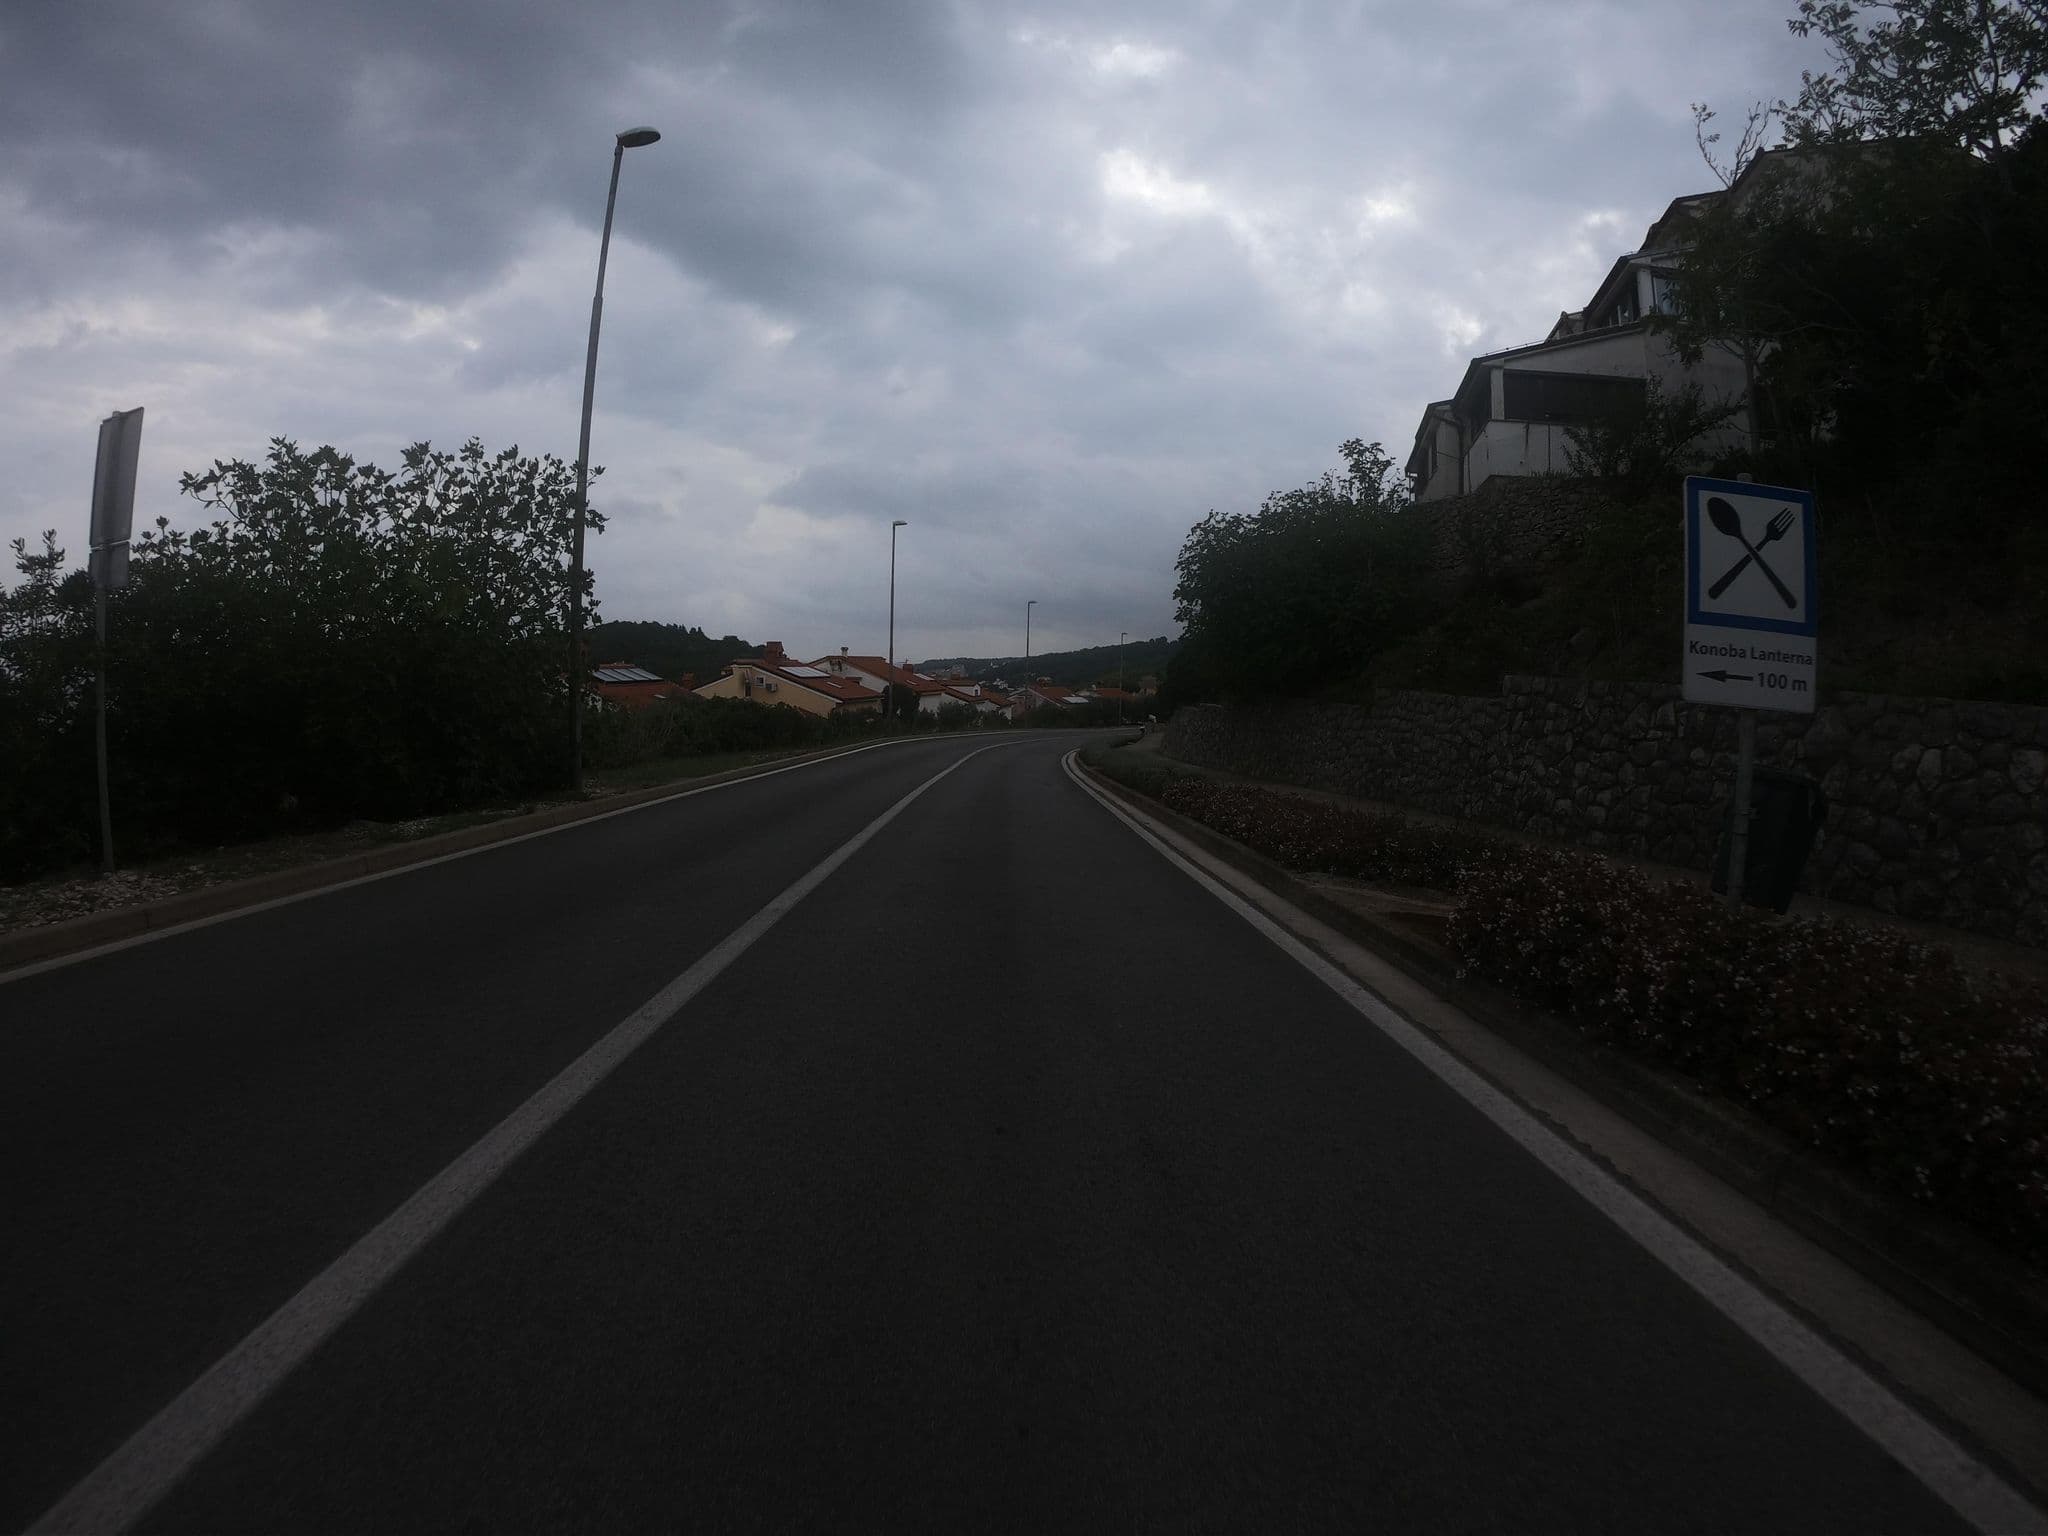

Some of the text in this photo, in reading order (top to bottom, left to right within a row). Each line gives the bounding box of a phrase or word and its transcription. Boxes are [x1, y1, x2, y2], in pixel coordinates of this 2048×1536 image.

[1689, 641, 1813, 665] Konoba Lanterna
[1758, 672, 1807, 692] 100 m
